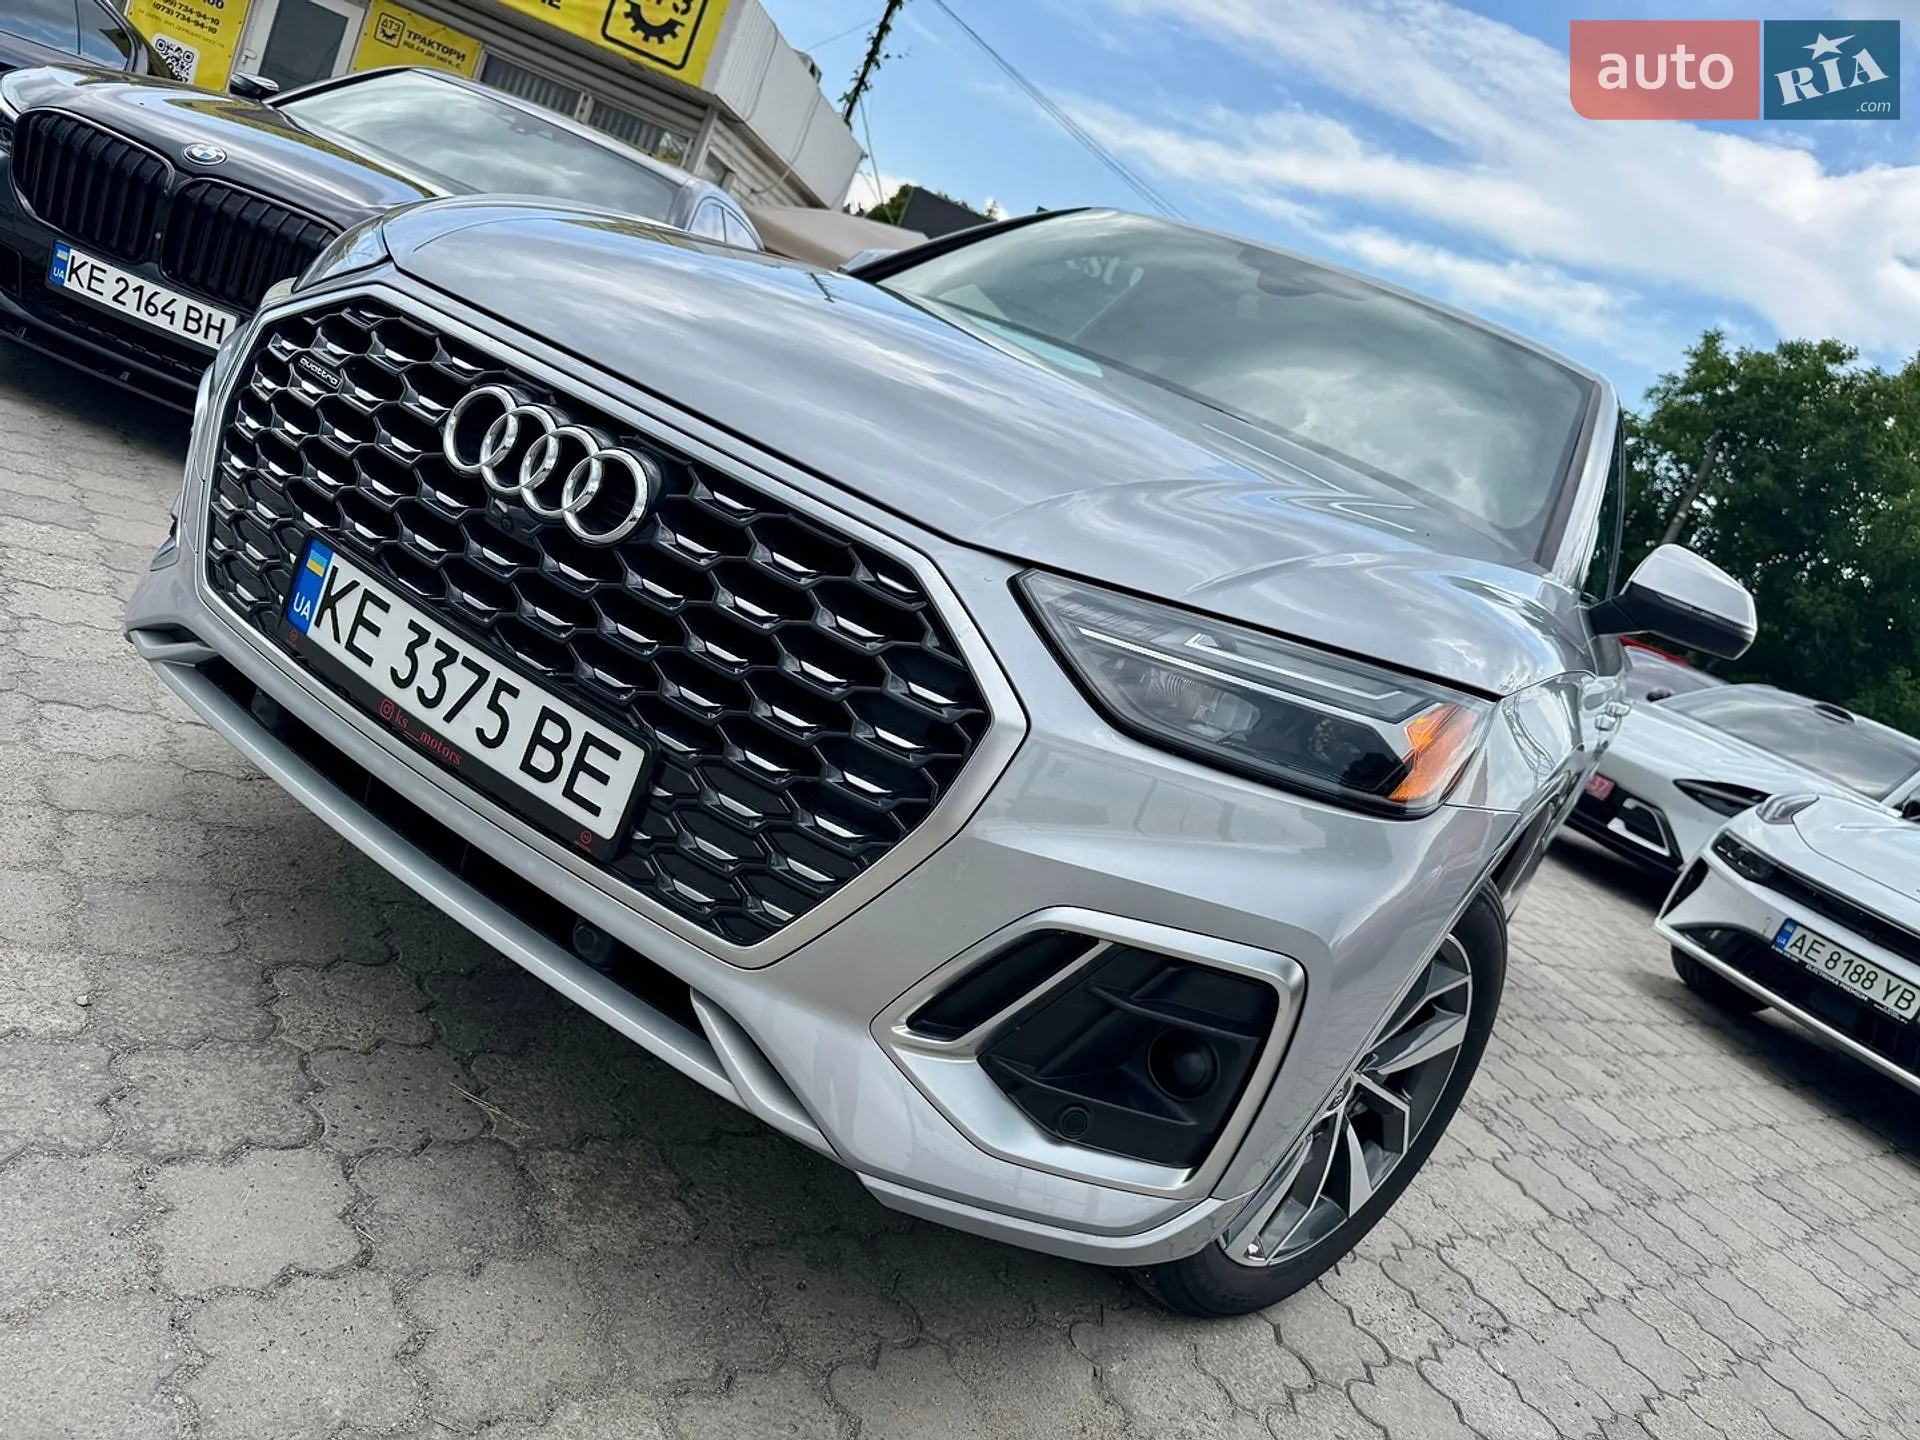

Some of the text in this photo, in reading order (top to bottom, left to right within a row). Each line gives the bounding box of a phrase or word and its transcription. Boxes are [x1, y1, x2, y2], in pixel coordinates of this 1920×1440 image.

[175, 11, 218, 35] 734-94-10
[407, 29, 466, 62] ТРАКТОРИ
[53, 267, 64, 280] UA
[67, 255, 227, 345] KE 2164 BH
[293, 591, 311, 620] UA
[314, 566, 622, 818] KE 3375 BE
[1789, 934, 1826, 963] AE
[1824, 951, 1879, 991] 8188
[1882, 979, 1917, 1011] YB
